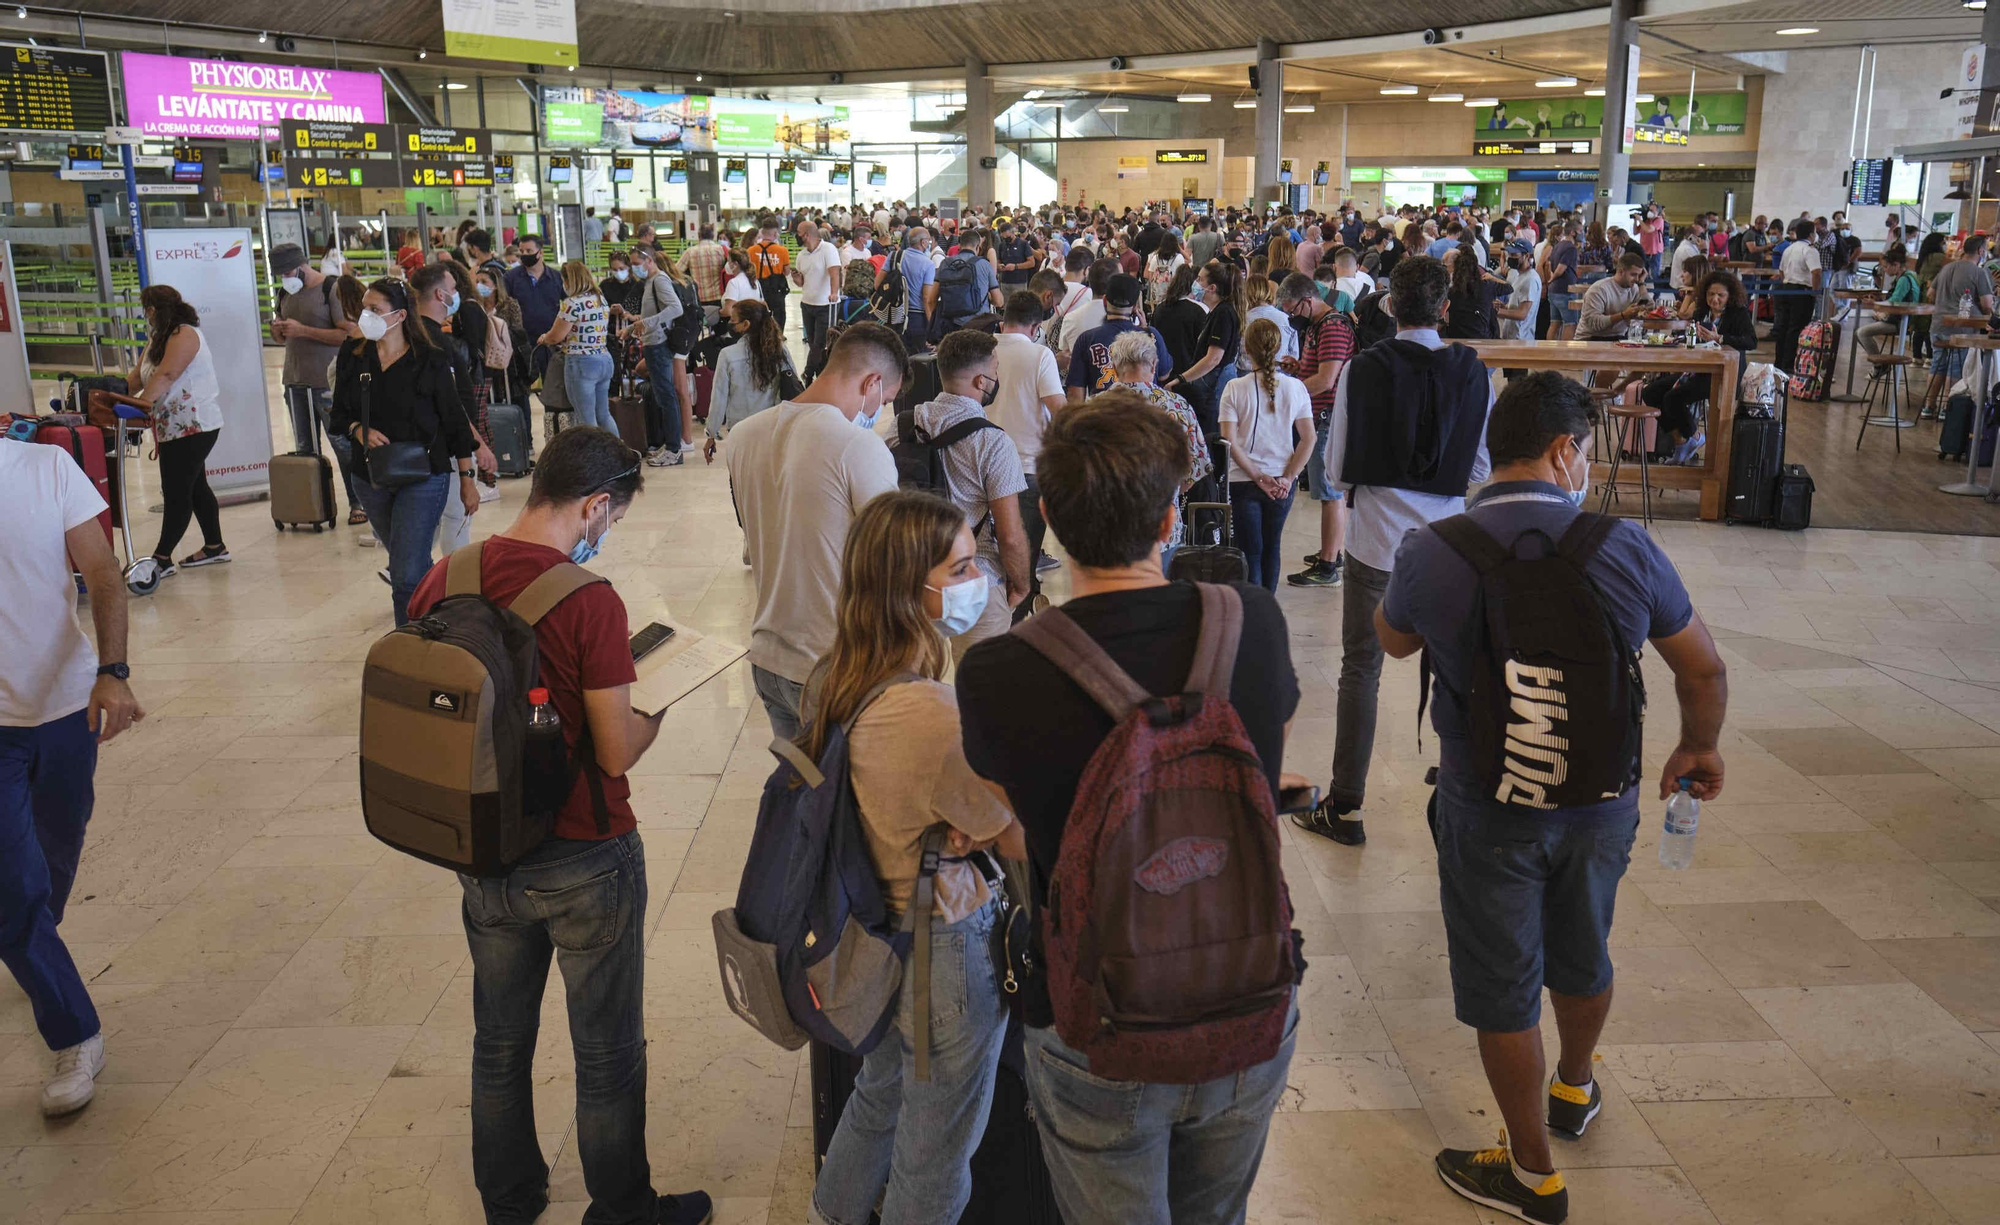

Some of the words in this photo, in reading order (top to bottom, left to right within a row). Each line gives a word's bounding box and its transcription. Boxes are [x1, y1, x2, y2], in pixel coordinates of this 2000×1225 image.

[189, 61, 327, 99] PHYSIORELAX
[157, 93, 274, 122] LEVÁNTATE
[274, 102, 287, 120] Y
[292, 103, 364, 123] CAMINA
[144, 122, 156, 132] LA
[158, 122, 188, 134] CREMA
[189, 124, 201, 134] DE
[203, 123, 234, 136] ACCIÓN
[235, 126, 262, 137] RÁPID
[1716, 124, 1740, 132] Binter
[310, 131, 329, 140] Security
[311, 139, 330, 147] Control
[338, 141, 364, 149] Seguridad
[421, 143, 437, 151] Control
[444, 144, 465, 152] Seguridad
[86, 146, 102, 159] 14
[187, 150, 201, 162] 15
[502, 156, 513, 166] 19
[559, 158, 570, 168] 20
[622, 158, 633, 168] 21
[675, 160, 687, 169] 22
[734, 161, 745, 170] 23
[328, 168, 342, 176] Gates
[352, 171, 359, 182] B
[456, 171, 461, 182] A
[1571, 171, 1598, 180] AirEurop
[329, 177, 349, 185] Puertas
[1494, 657, 1570, 811] PUMA
